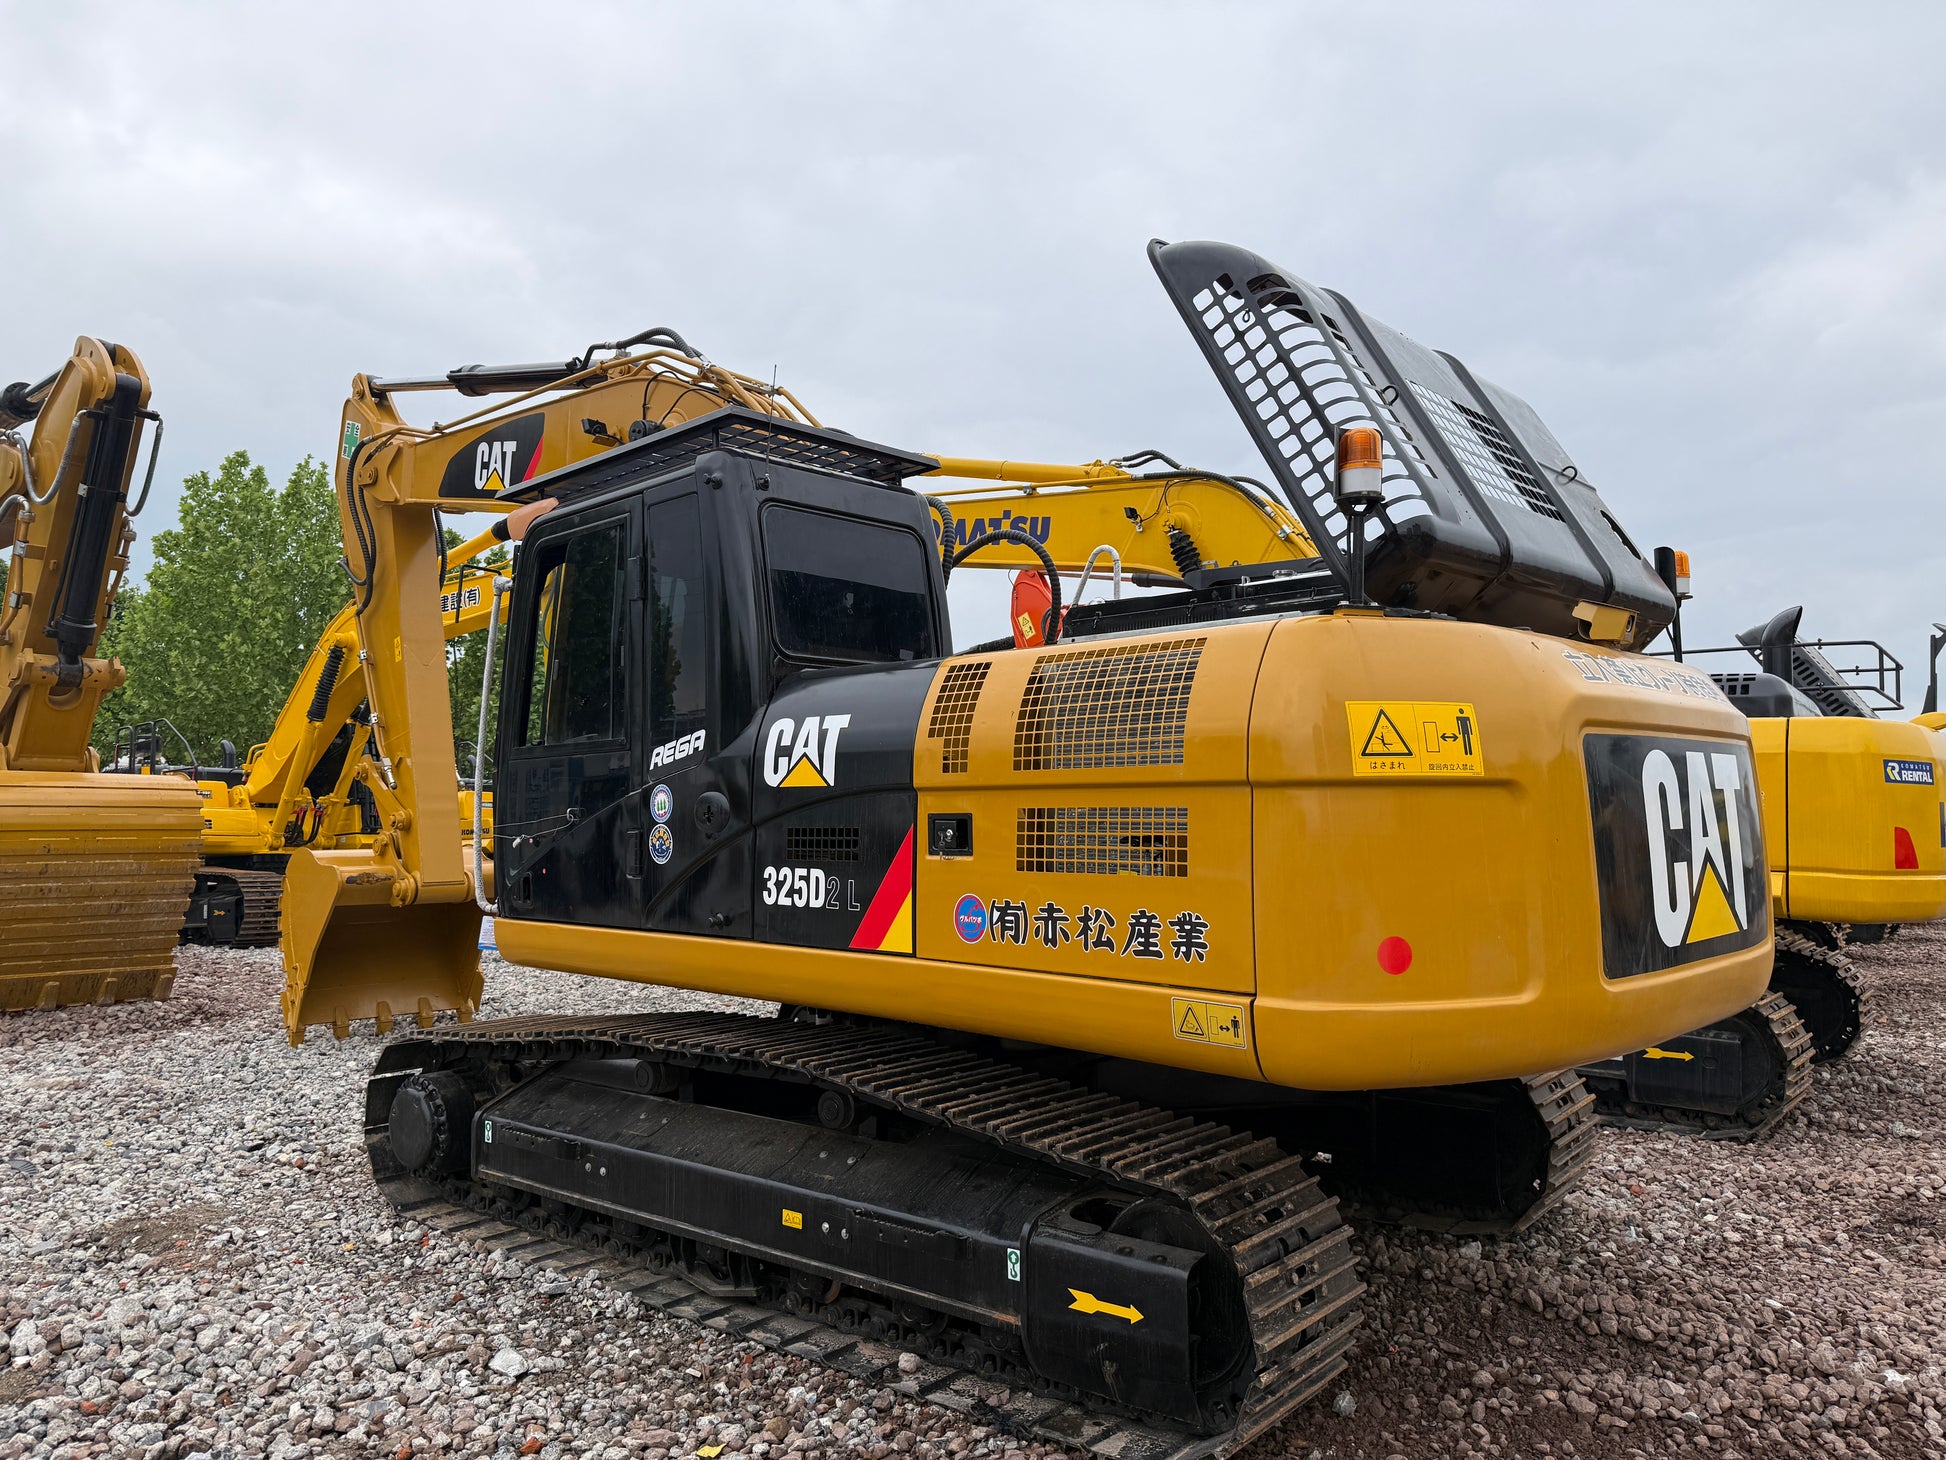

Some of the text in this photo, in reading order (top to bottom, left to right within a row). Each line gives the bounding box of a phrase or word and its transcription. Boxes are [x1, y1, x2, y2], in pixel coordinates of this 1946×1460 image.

[474, 441, 517, 490] CAT
[931, 509, 1052, 547] MATSU
[649, 729, 706, 770] REGA
[763, 713, 851, 787] CAT
[1369, 761, 1406, 770] はさまれ
[1901, 770, 1933, 783] RENTAL
[1642, 749, 1748, 948] CAT
[988, 898, 1210, 963] (有)赤松産業
